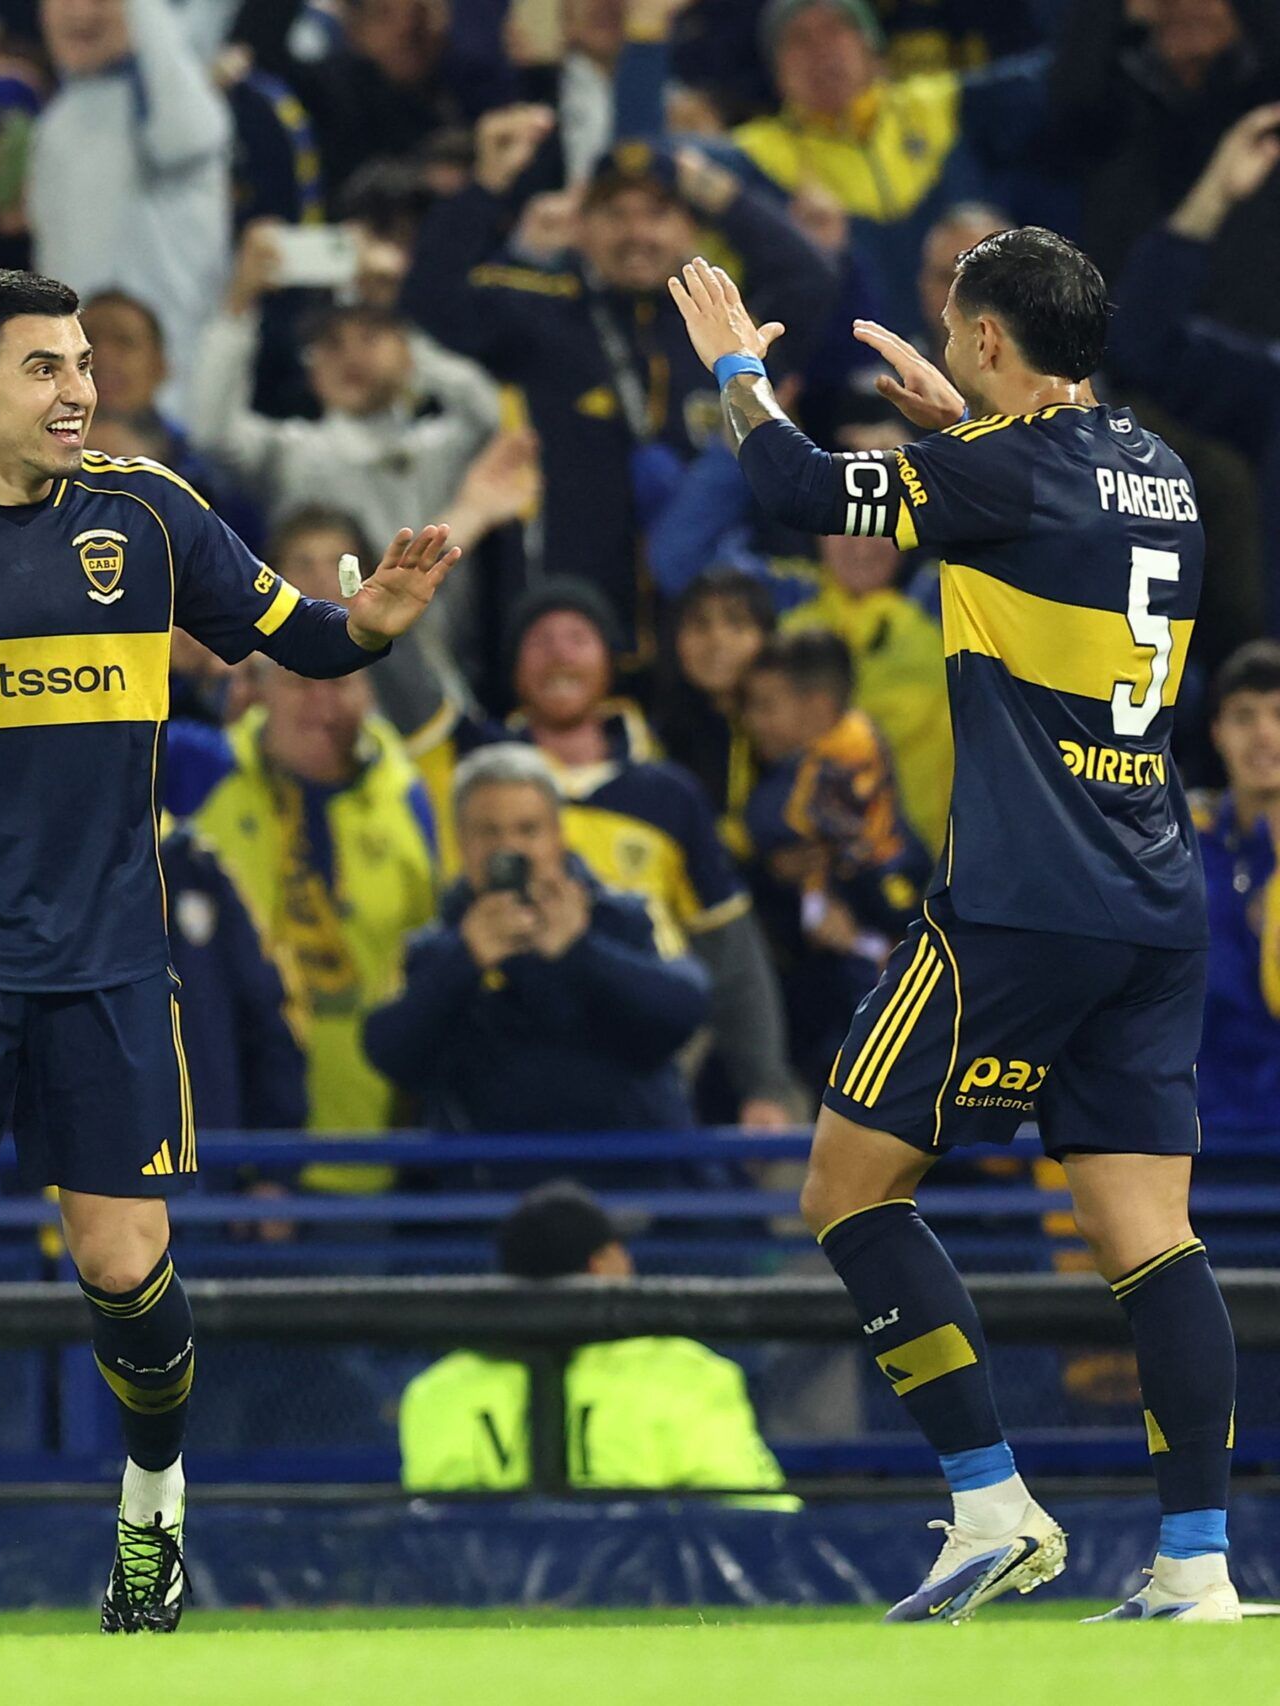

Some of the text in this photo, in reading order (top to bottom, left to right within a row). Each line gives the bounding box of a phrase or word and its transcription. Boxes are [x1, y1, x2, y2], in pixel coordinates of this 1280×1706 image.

[1096, 467, 1198, 522] PAREDES
[88, 559, 117, 570] CABJ
[1111, 546, 1181, 737] 5
